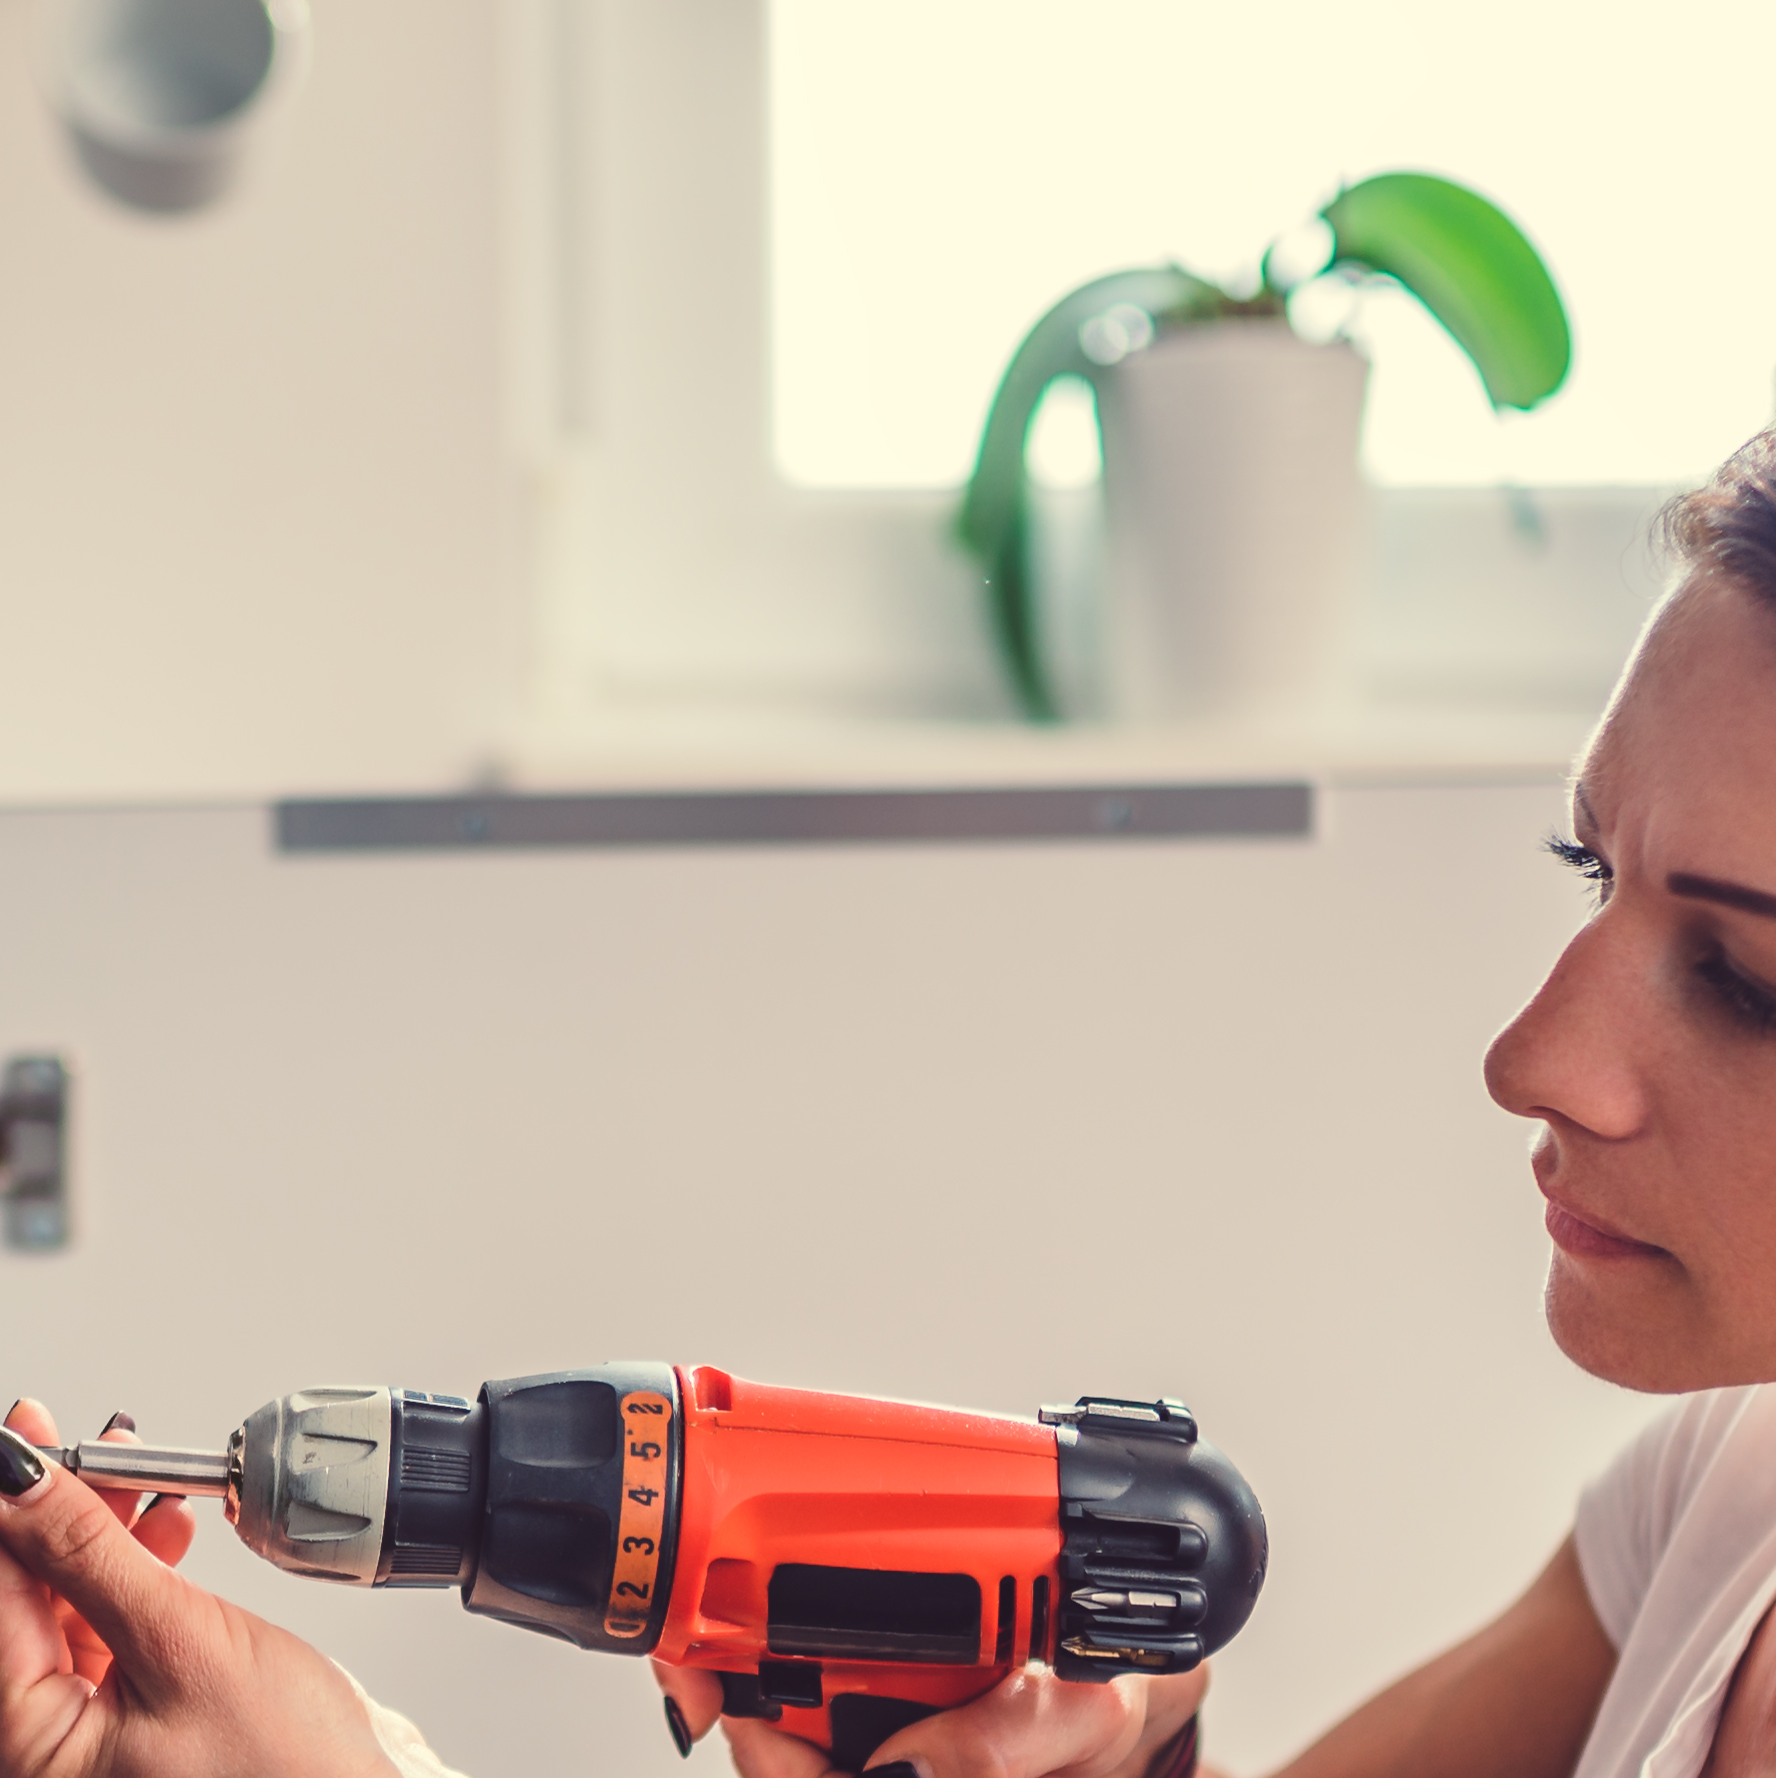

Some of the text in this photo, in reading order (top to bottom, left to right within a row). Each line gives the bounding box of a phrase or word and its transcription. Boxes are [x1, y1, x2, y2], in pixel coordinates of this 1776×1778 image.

[616, 1441, 662, 1599] 2 3 4 5
